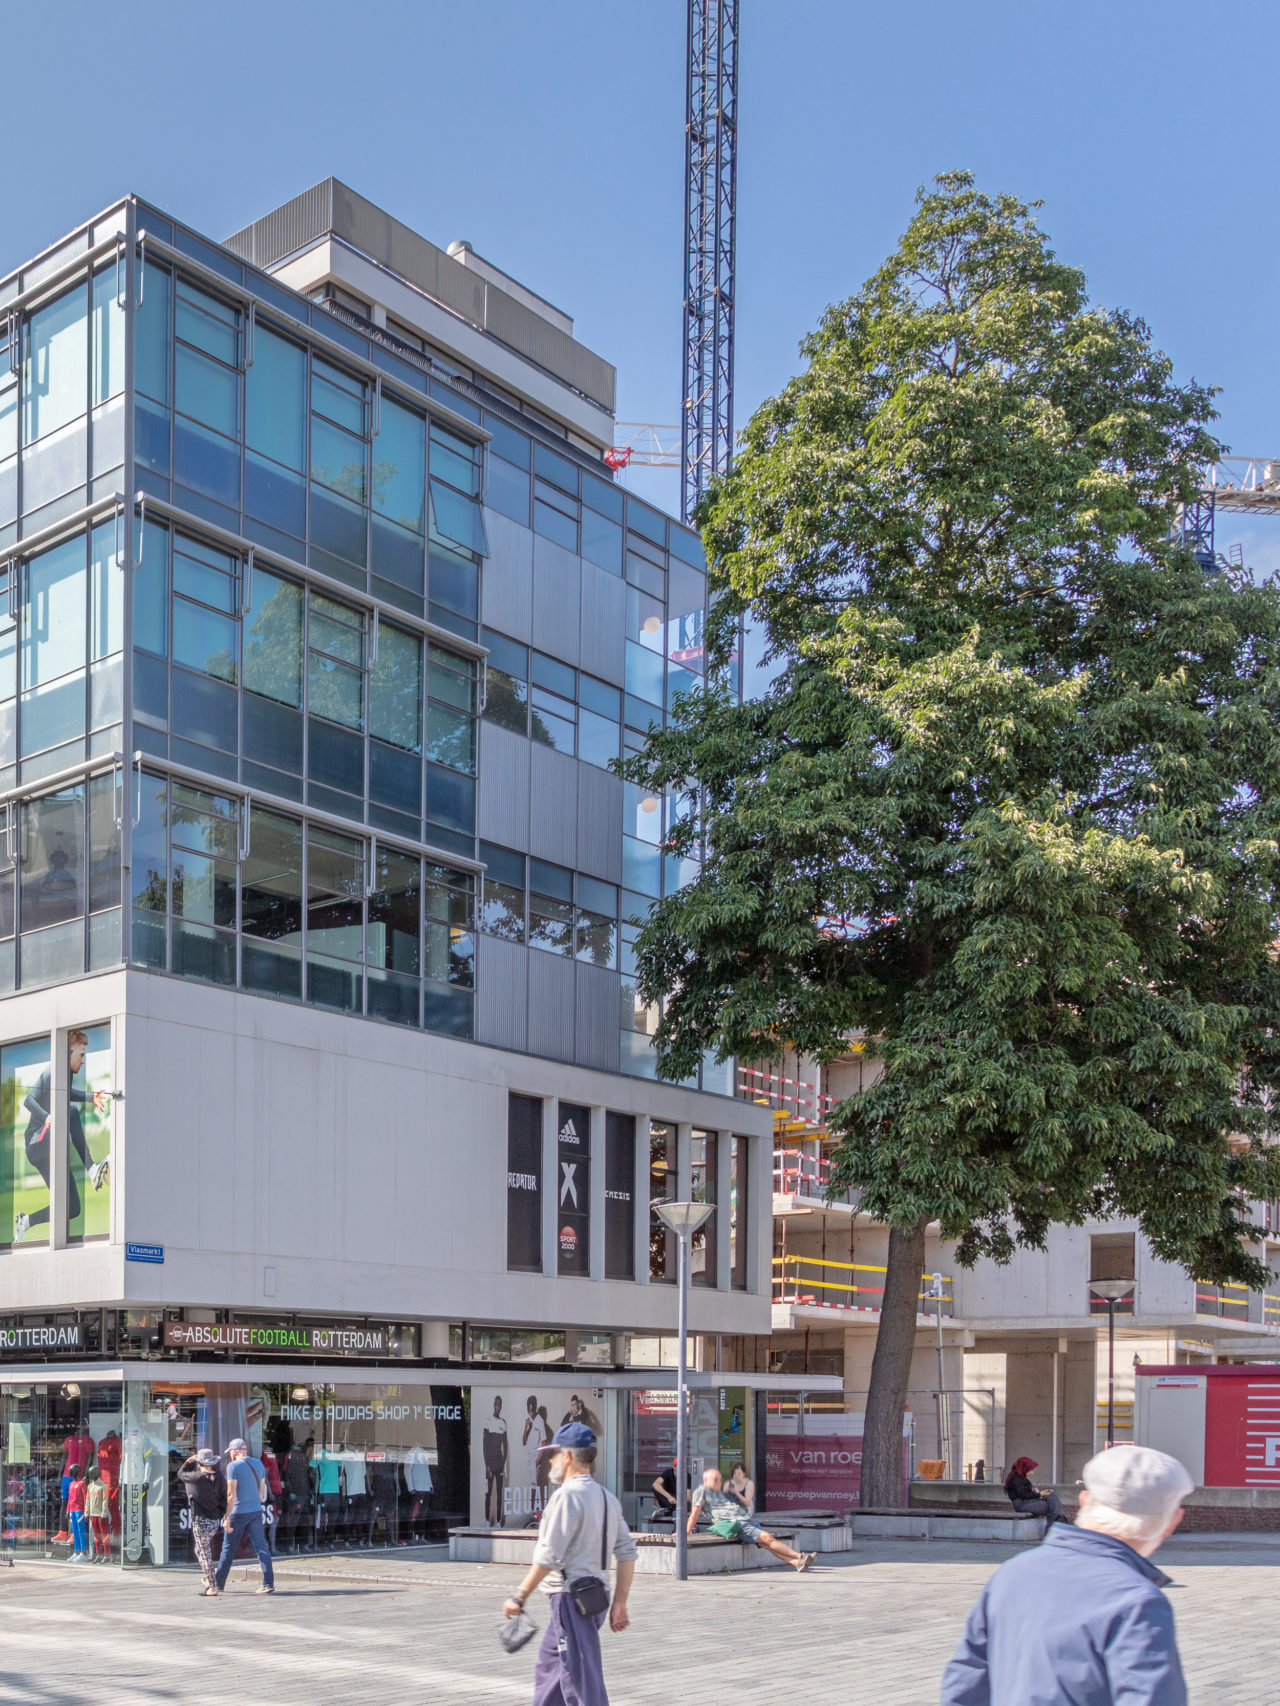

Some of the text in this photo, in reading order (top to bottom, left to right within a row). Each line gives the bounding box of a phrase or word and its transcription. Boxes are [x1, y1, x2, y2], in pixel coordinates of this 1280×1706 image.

[559, 1134, 579, 1144] adidas
[561, 1162, 577, 1209] X
[604, 1190, 630, 1200] EMESIS
[130, 1246, 161, 1256] Vlasmarkt
[0, 1327, 79, 1347] ROTTERDAM
[313, 1330, 382, 1348] ROTTERDAM
[280, 1405, 310, 1420] NIKE
[313, 1405, 323, 1420] &
[326, 1405, 373, 1420] ADIDAS
[376, 1405, 409, 1420] SHOP
[424, 1405, 461, 1420] ETAGE
[790, 1451, 863, 1464] van roe
[131, 1483, 139, 1532] SOCCER
[504, 1485, 550, 1515] EQUAL
